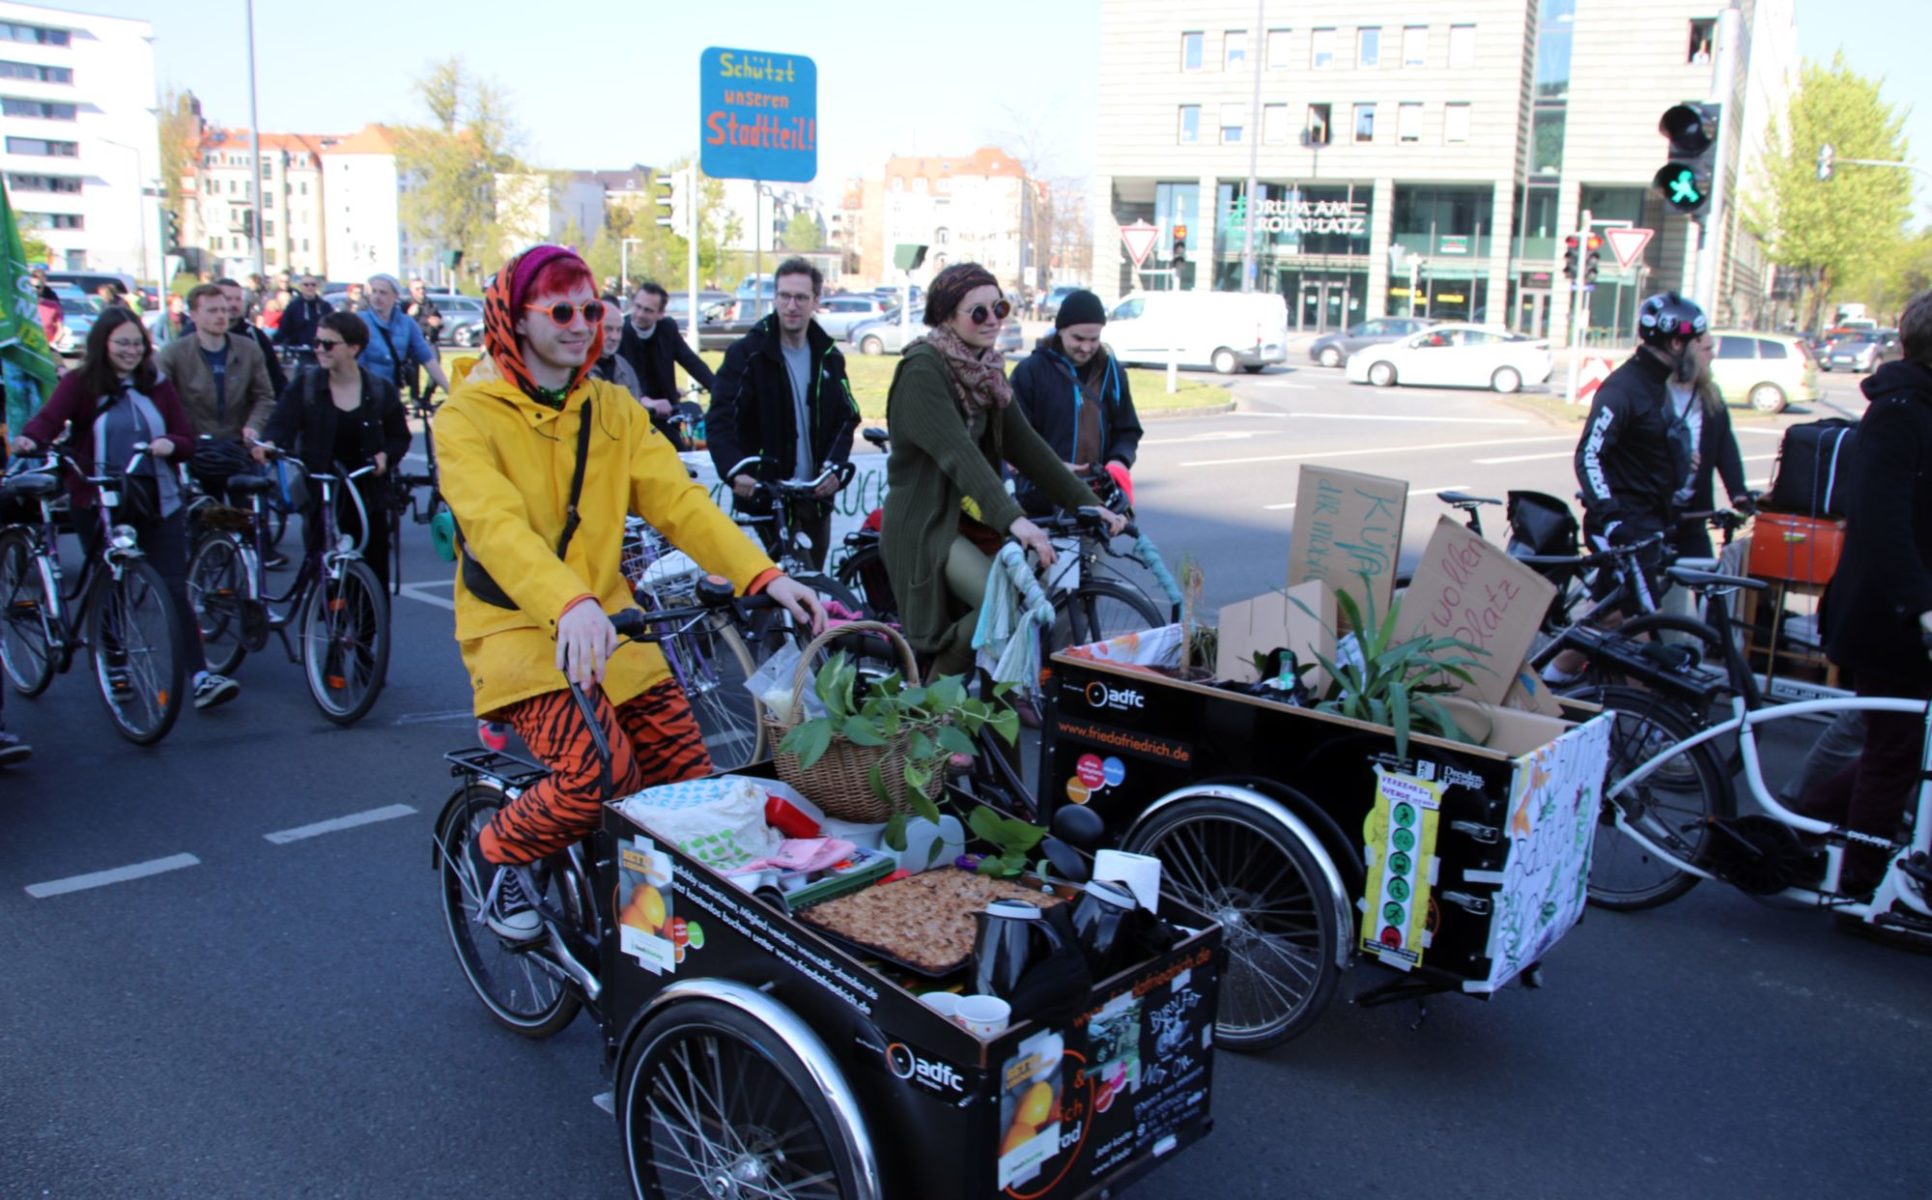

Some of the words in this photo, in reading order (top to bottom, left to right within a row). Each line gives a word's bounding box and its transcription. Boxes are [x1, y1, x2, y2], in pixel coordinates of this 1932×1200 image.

[720, 53, 795, 82] Schützt
[724, 89, 789, 108] unseren
[707, 111, 815, 150] Stadtteil!
[1314, 200, 1350, 217] AM
[1431, 537, 1487, 628] wollen
[1108, 686, 1145, 709] adfc
[1058, 720, 1190, 763] www.friedafriedrich.de
[916, 1057, 964, 1092] adfc
